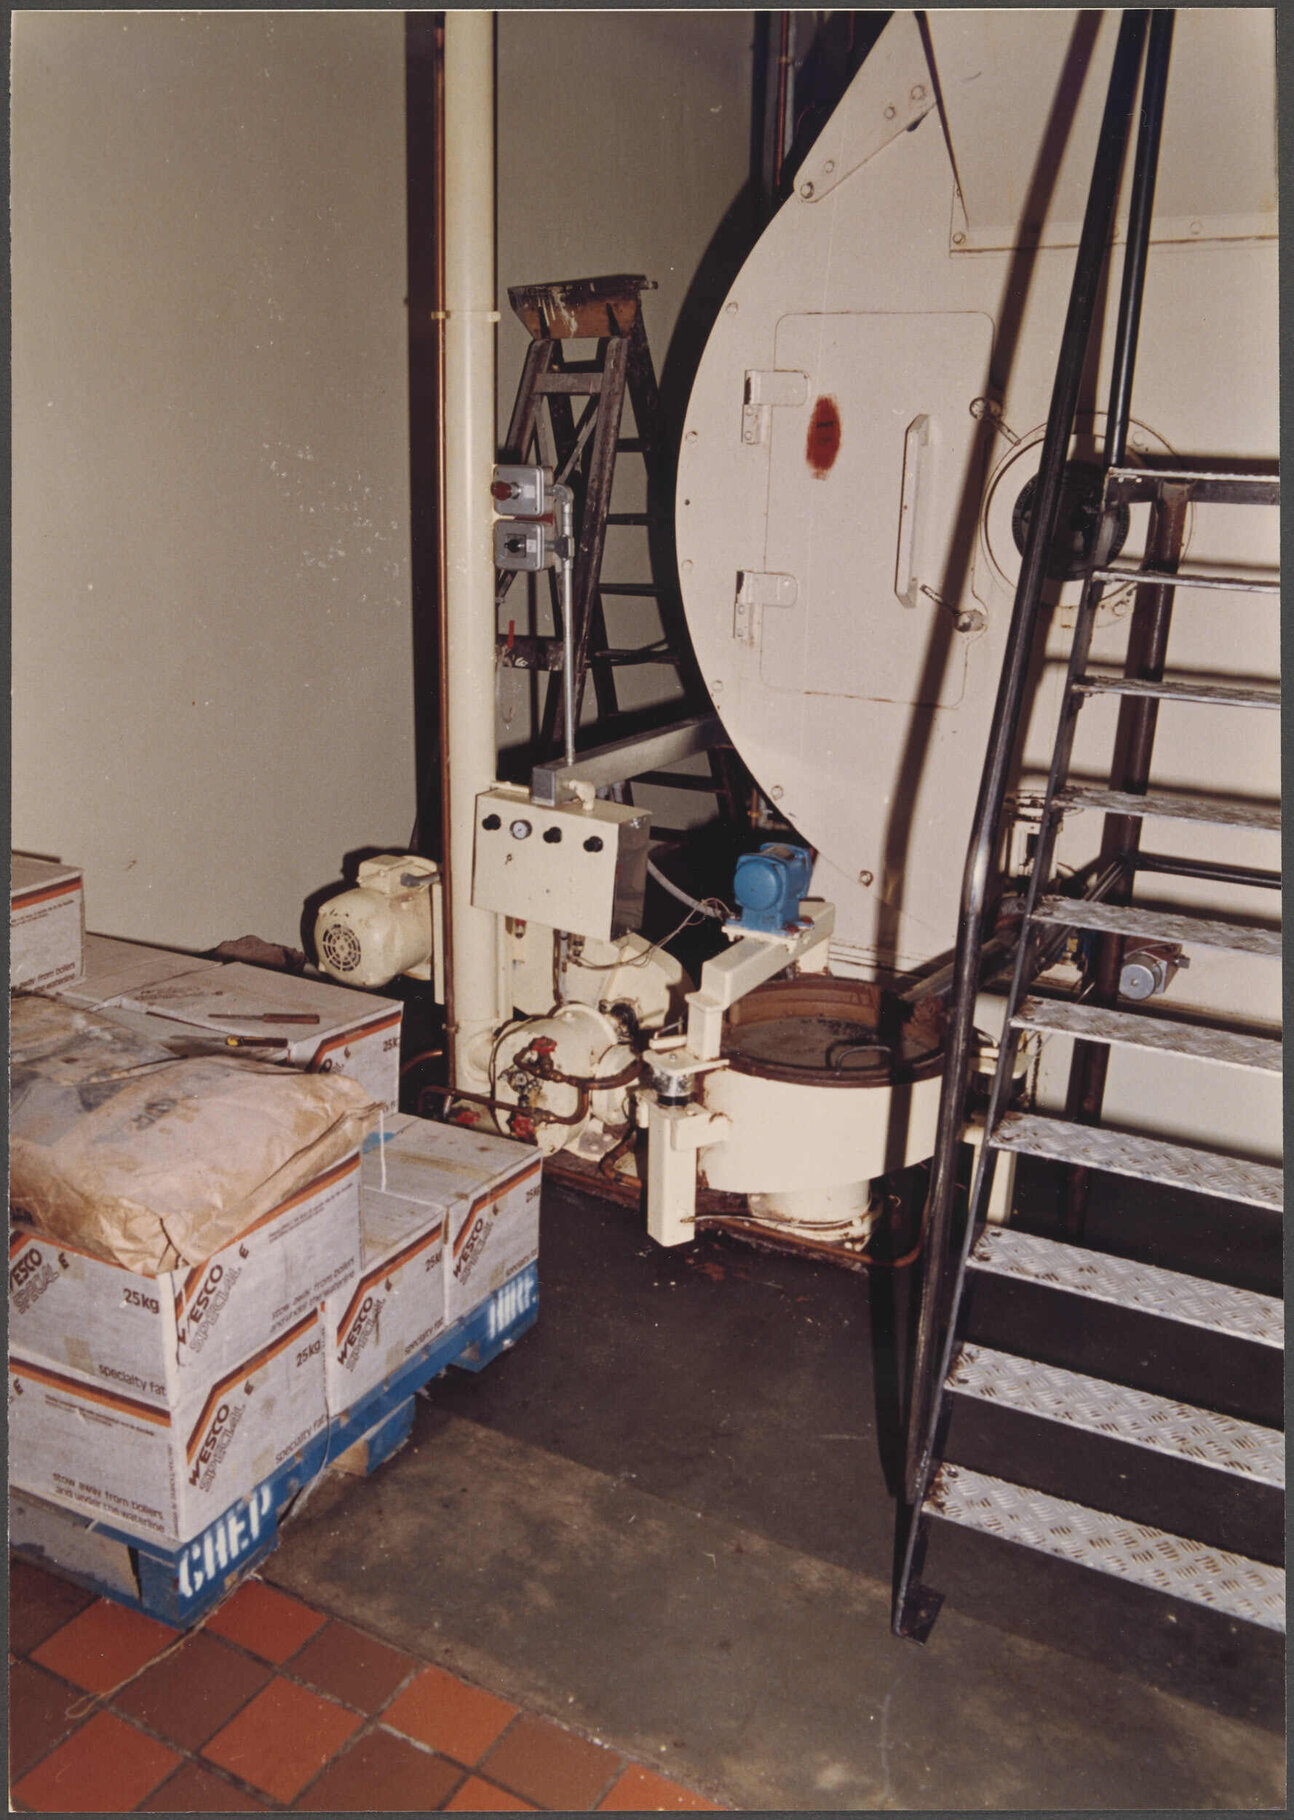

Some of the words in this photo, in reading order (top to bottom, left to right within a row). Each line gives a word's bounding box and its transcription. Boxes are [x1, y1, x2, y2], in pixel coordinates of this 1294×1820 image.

[9, 1248, 42, 1294] ESCO
[453, 1218, 484, 1278] WESCO
[122, 1288, 160, 1315] 25kg
[337, 1297, 373, 1365] WESCO
[98, 1364, 147, 1392] specialty
[149, 1381, 167, 1397] fat
[189, 1404, 230, 1486] WESCO
[104, 1489, 129, 1507] from
[131, 1500, 163, 1520] boilers
[121, 1510, 164, 1533] waterline
[178, 1484, 272, 1598] CHEP
